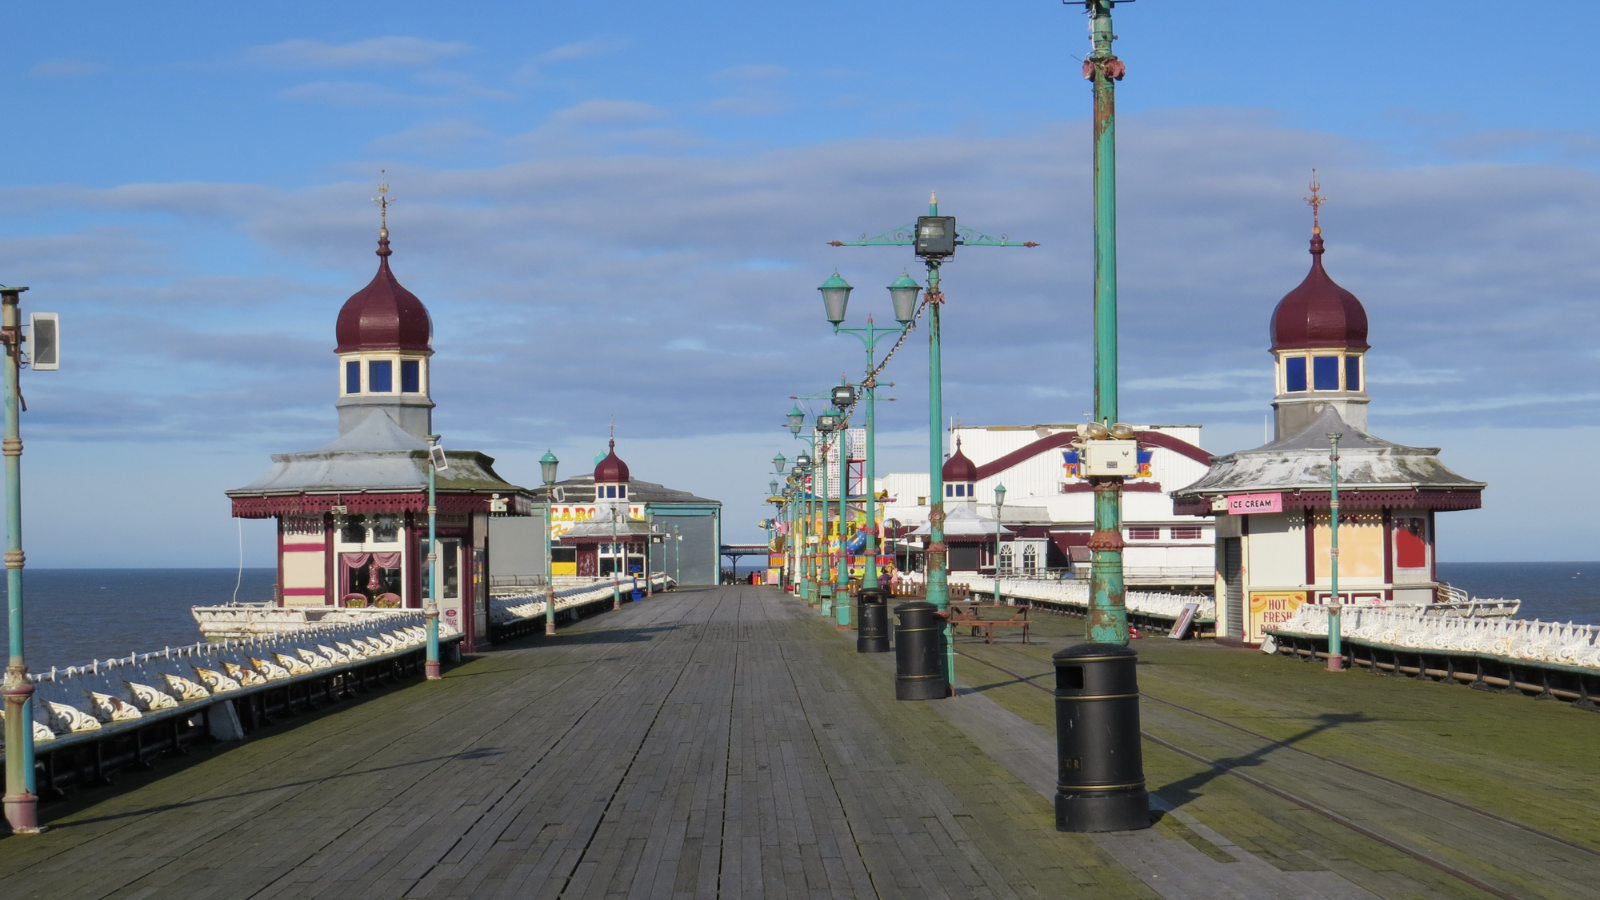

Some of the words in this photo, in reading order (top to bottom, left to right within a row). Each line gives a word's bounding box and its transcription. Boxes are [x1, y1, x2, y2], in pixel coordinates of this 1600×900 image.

[1245, 500, 1272, 508] CREAM
[1268, 599, 1287, 610] HOT
[1263, 612, 1292, 623] FRESH
